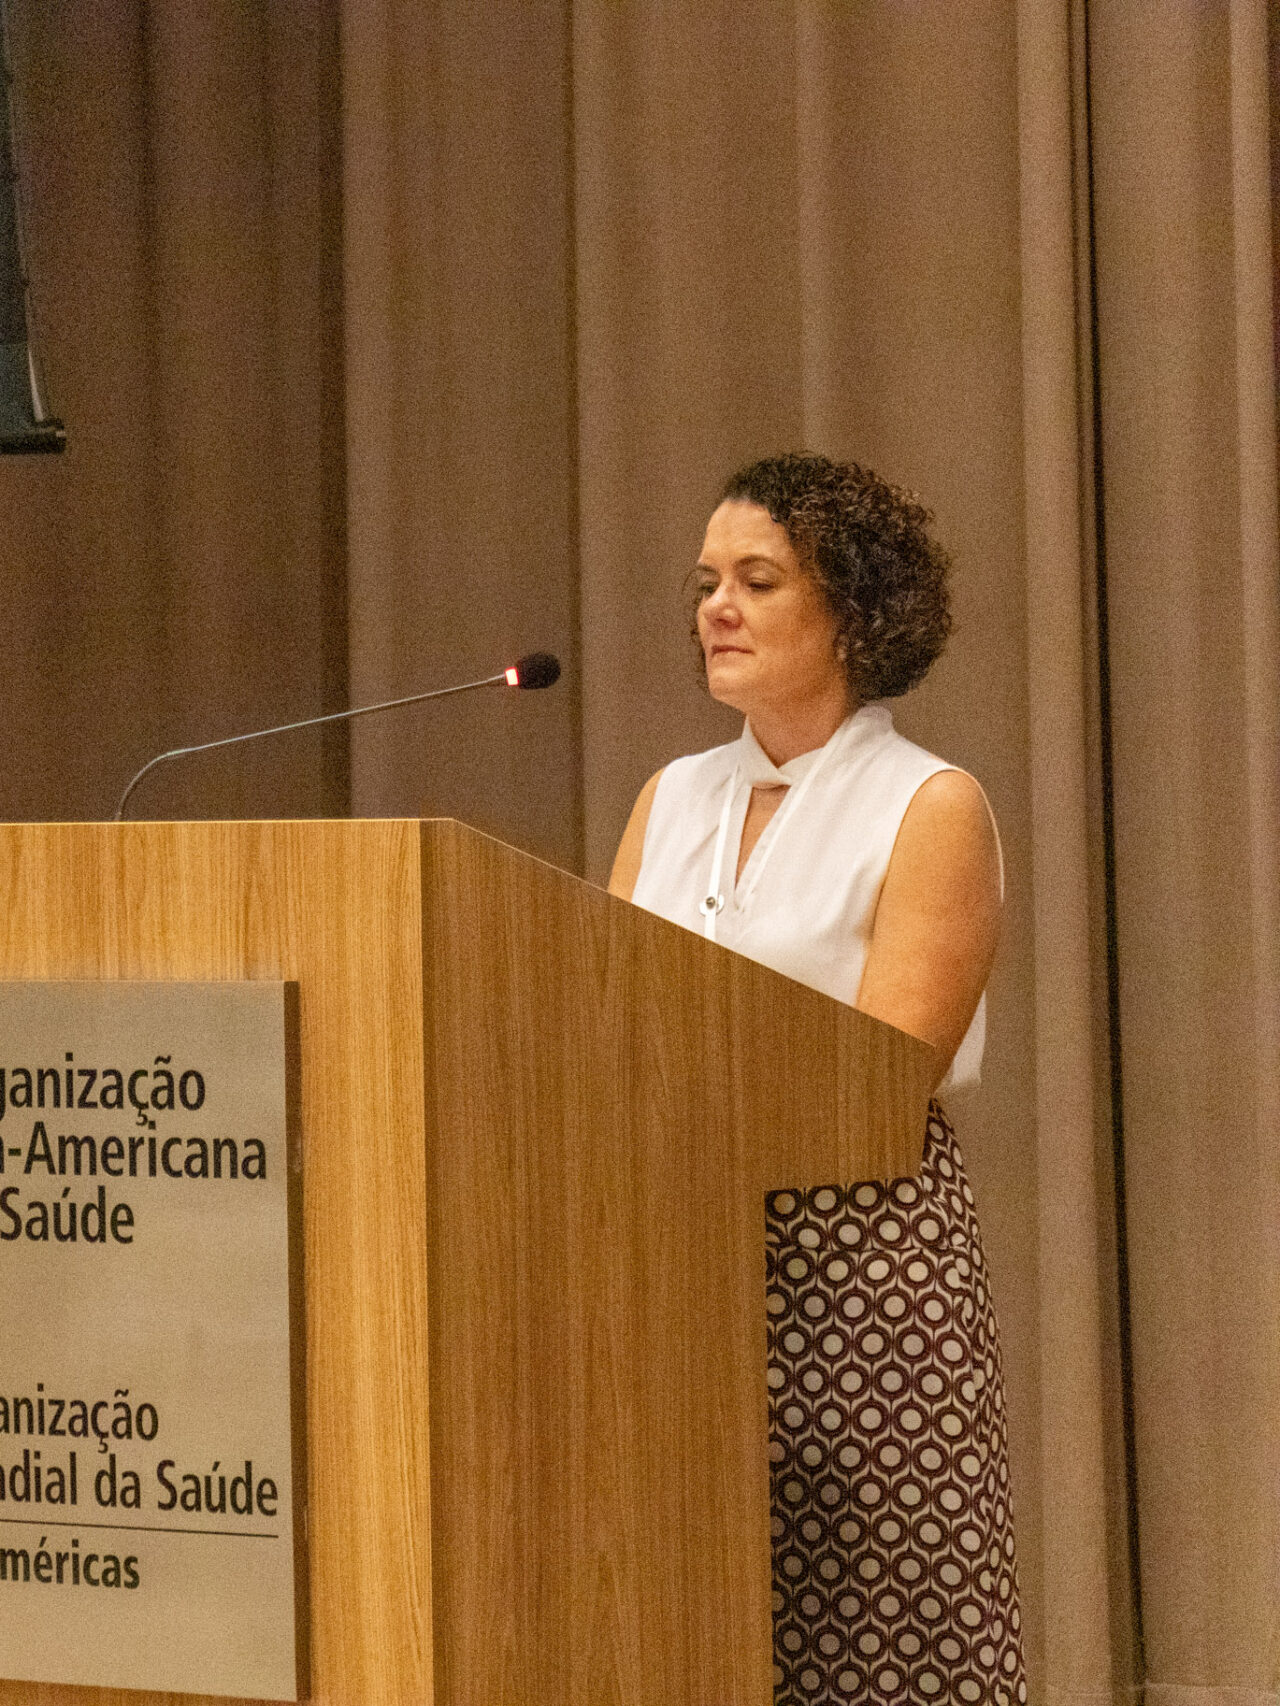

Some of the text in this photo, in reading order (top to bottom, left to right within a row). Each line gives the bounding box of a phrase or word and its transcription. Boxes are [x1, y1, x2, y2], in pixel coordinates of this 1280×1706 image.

[0, 1185, 135, 1244] Saúde
[95, 1452, 141, 1509] da
[157, 1458, 279, 1517] Saúde
